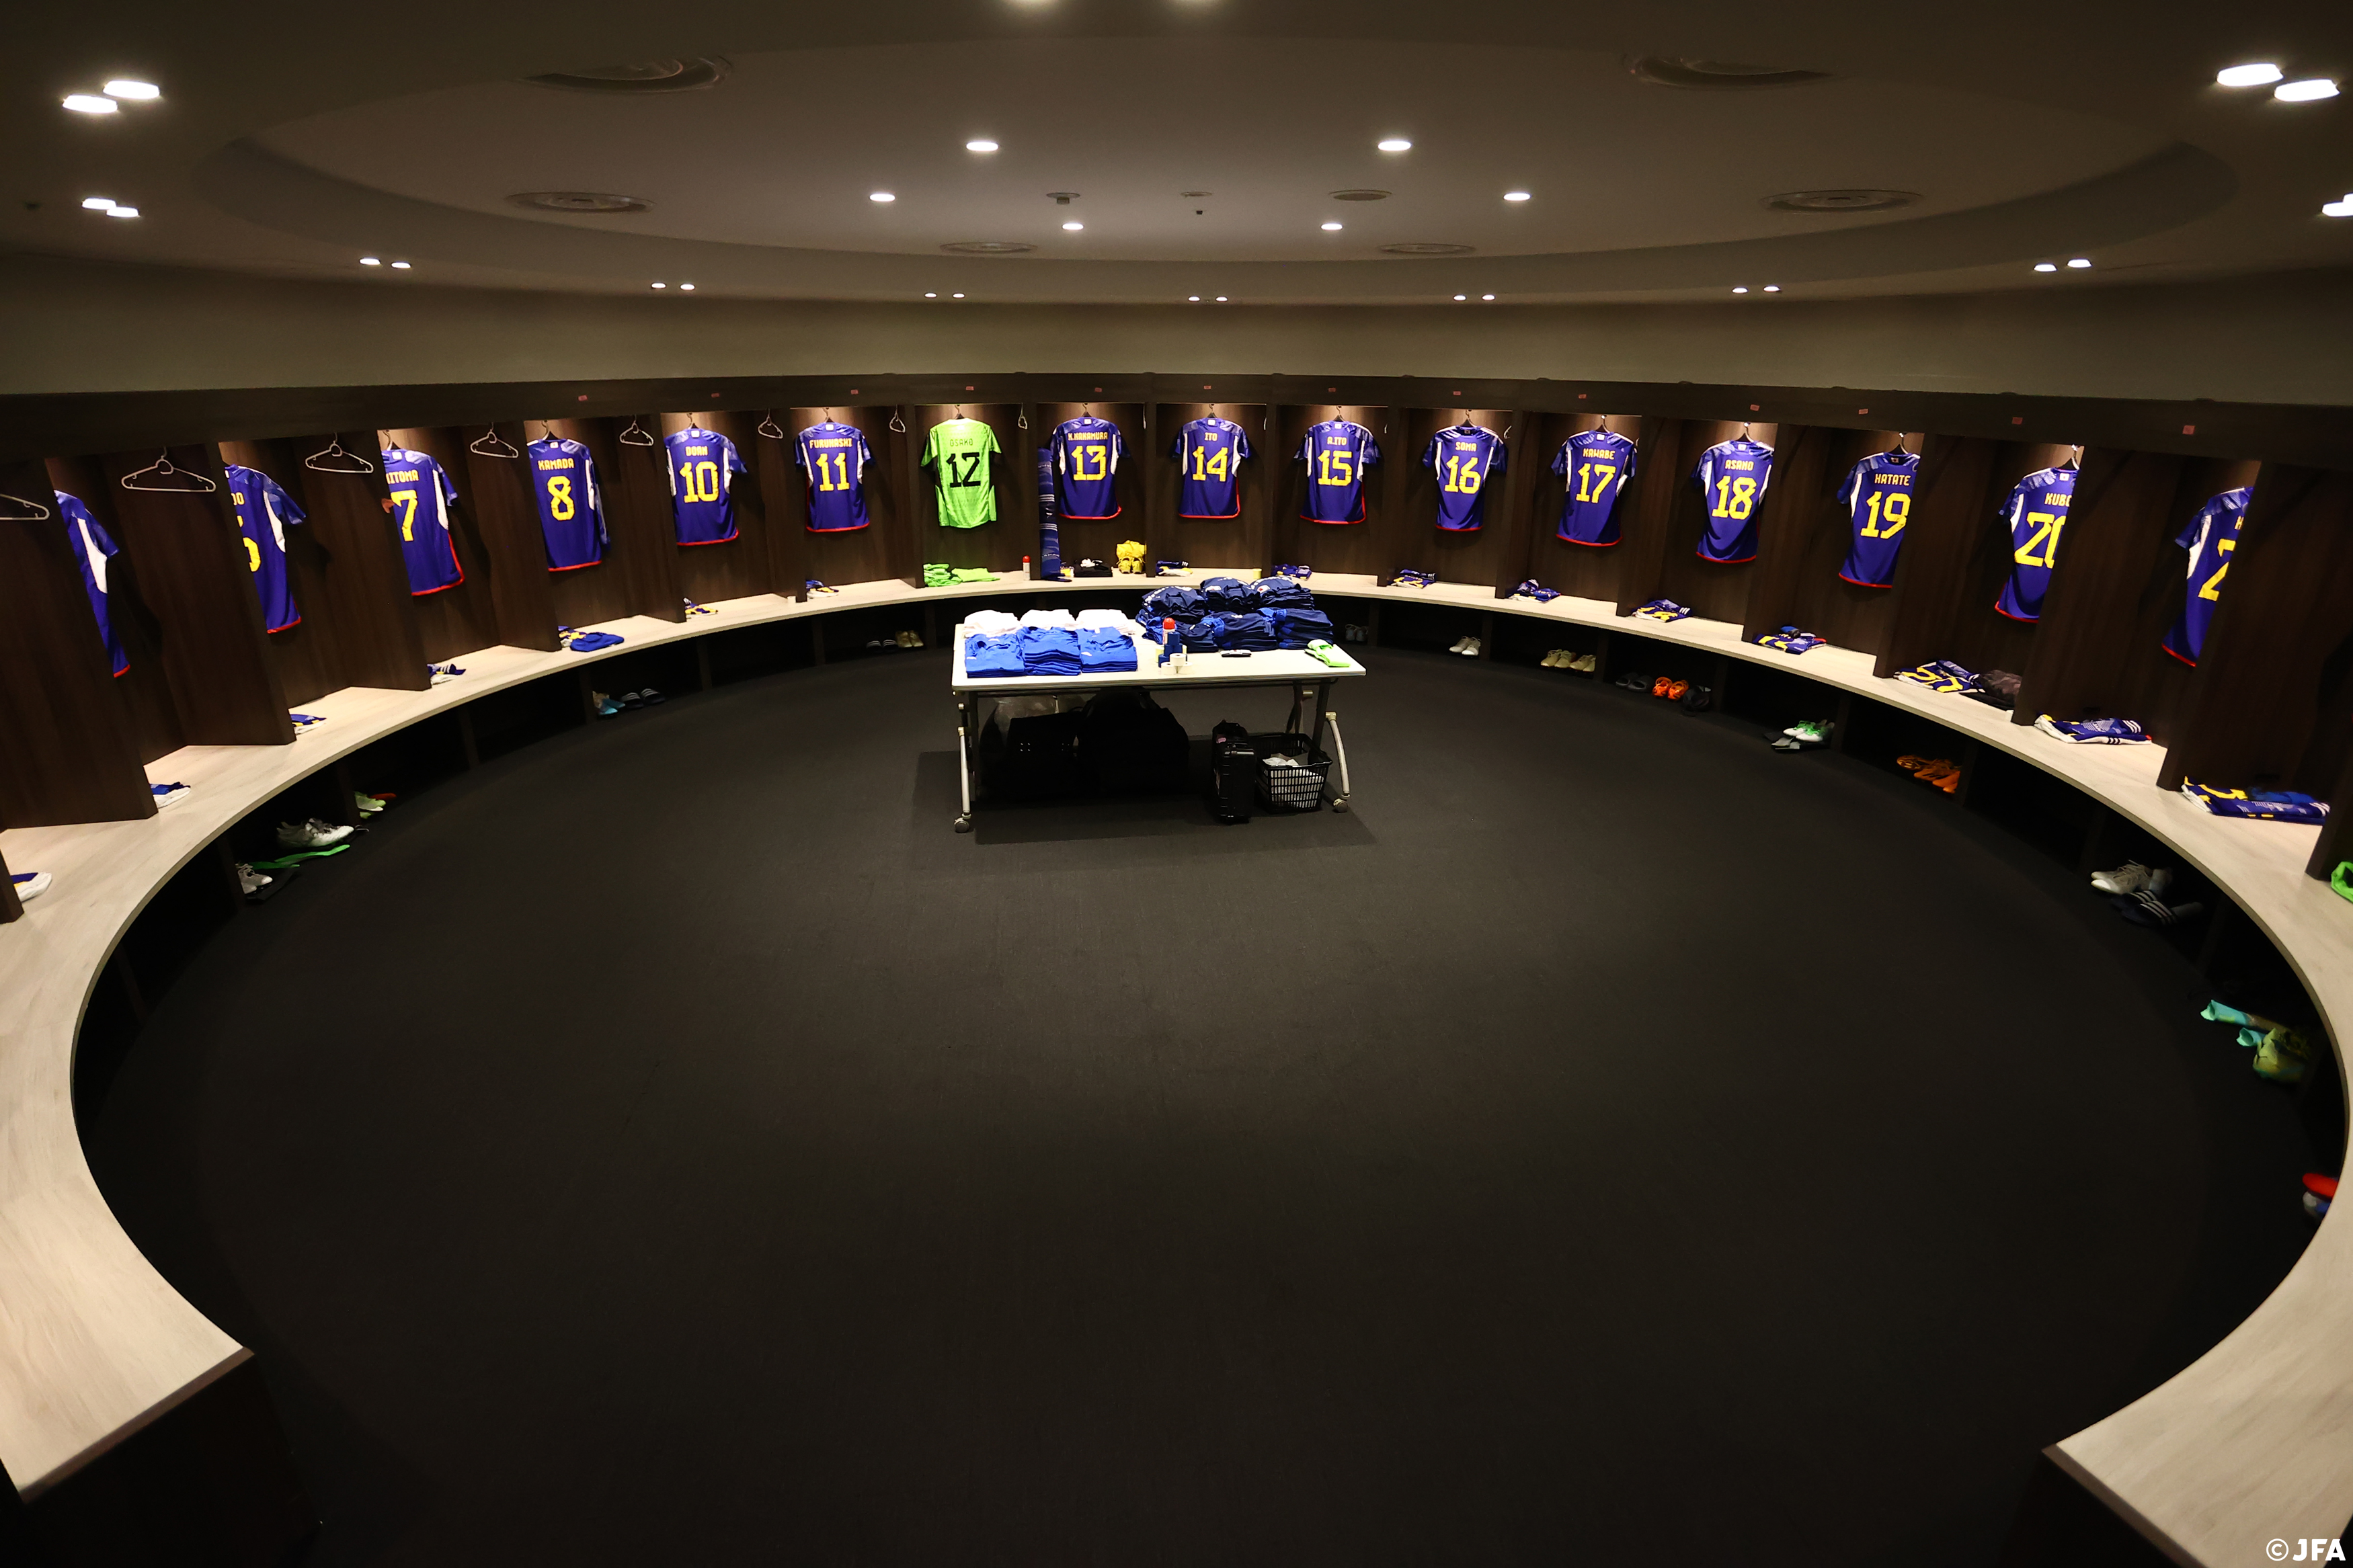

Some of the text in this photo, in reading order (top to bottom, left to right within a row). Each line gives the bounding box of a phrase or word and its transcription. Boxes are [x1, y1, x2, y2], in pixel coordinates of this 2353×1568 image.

[685, 446, 709, 456] DOAN
[809, 438, 852, 450] FURUHASHI
[950, 438, 973, 447] OSAKO
[1204, 432, 1218, 441] ITO
[1326, 436, 1347, 446] A.ITO
[1455, 441, 1477, 452] SOMA
[1583, 448, 1616, 460] KAWABE
[537, 458, 575, 470] KAMADA
[815, 453, 850, 491] 11
[946, 452, 981, 488] 12
[1071, 445, 1107, 481] 13
[1192, 446, 1228, 482] 14
[1318, 450, 1353, 487] 15
[1443, 455, 1482, 495] 16
[1724, 459, 1755, 471] ASANO
[1874, 473, 1912, 487] HATATE
[547, 476, 575, 521] 8
[679, 461, 719, 503] 10
[1575, 462, 1617, 504] 17
[1711, 475, 1758, 520] 18
[391, 489, 418, 542] 7
[1860, 491, 1912, 540] 19
